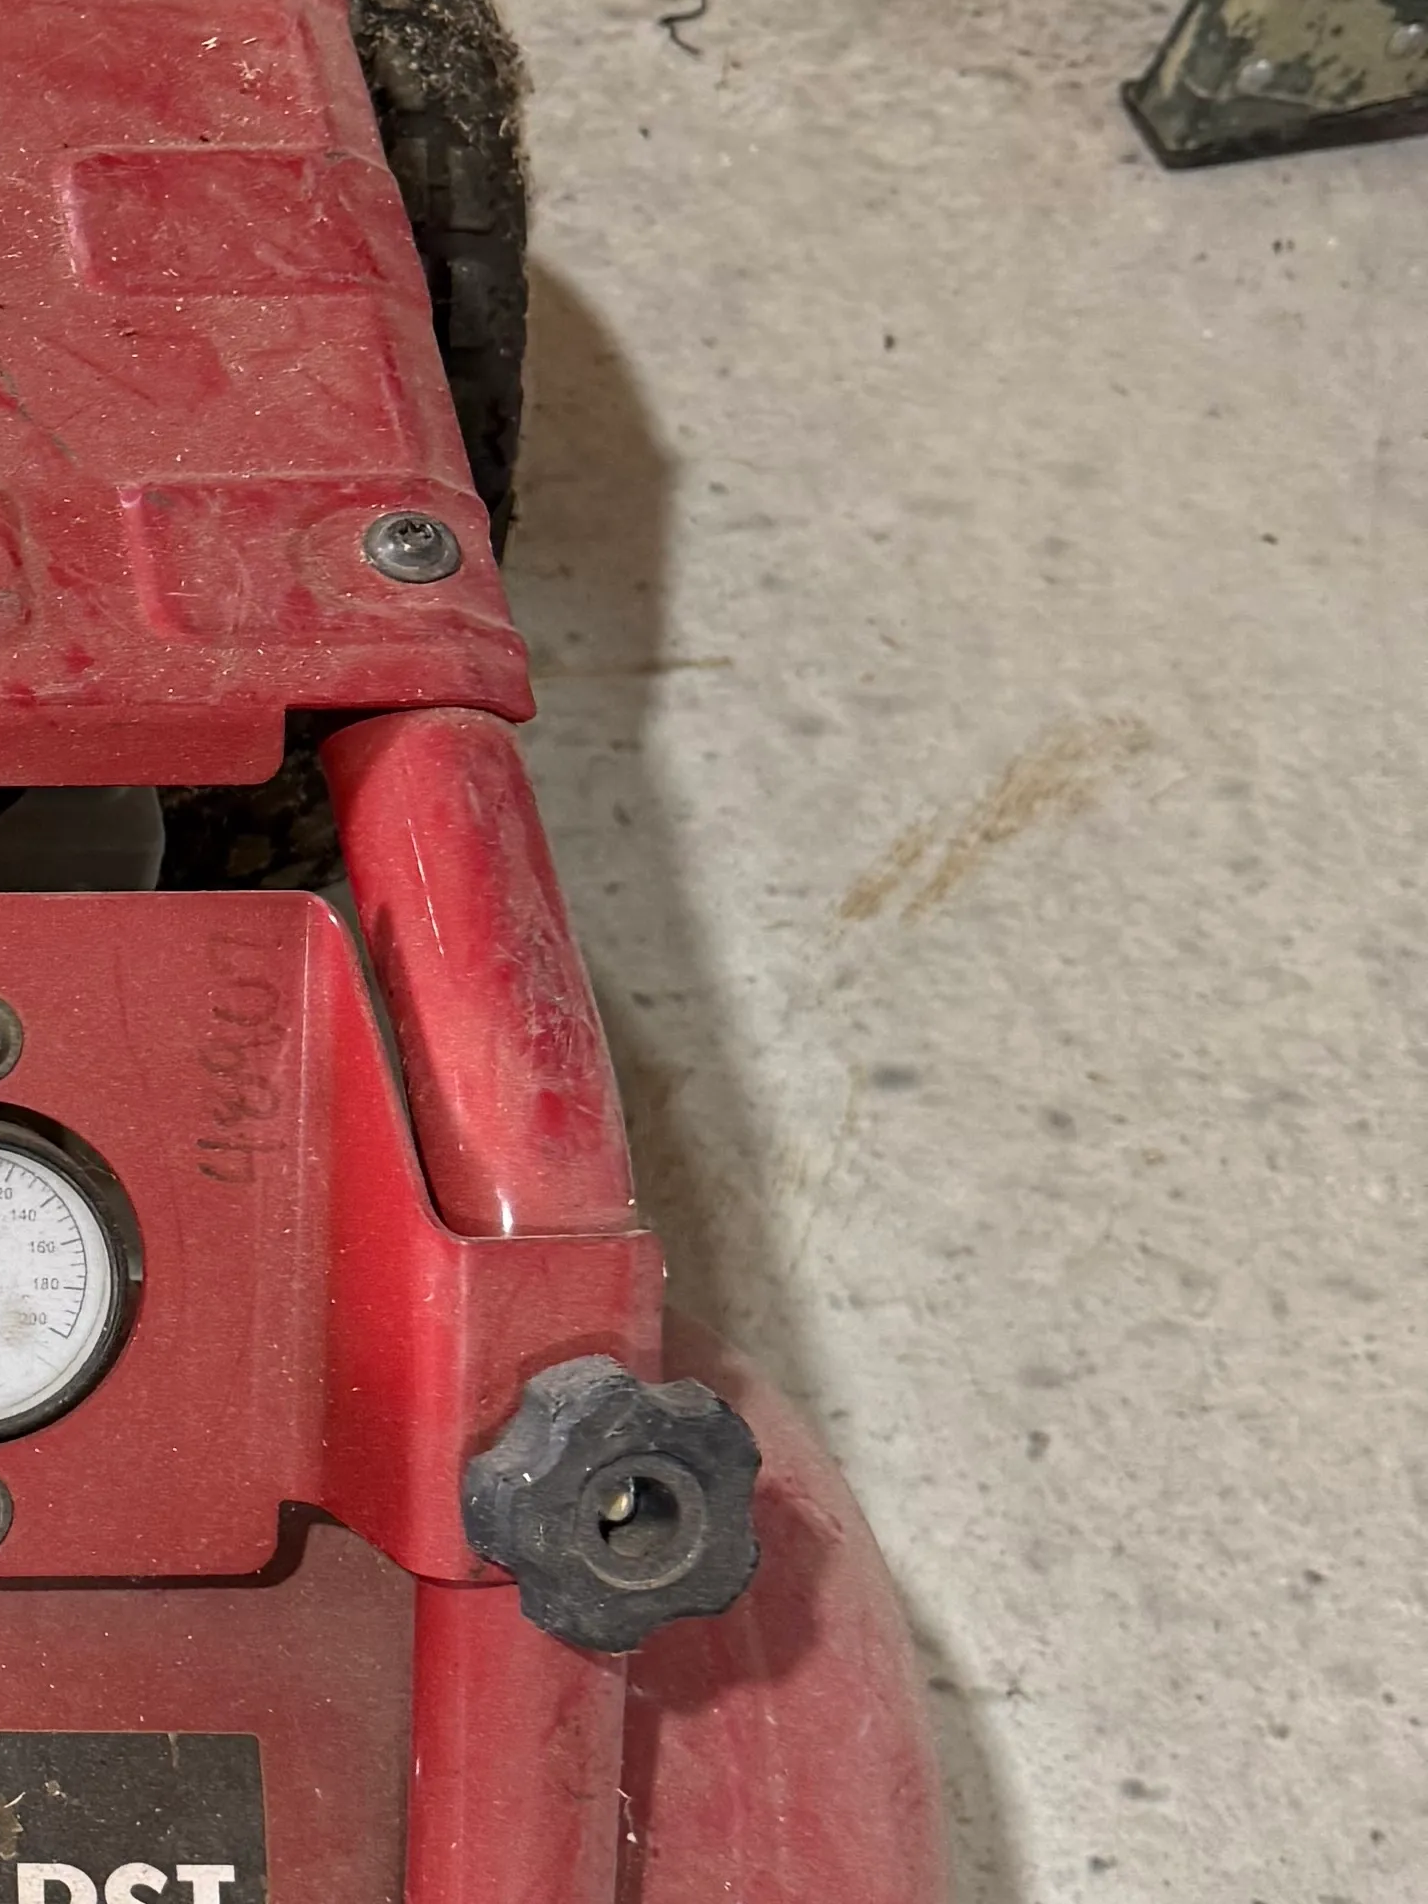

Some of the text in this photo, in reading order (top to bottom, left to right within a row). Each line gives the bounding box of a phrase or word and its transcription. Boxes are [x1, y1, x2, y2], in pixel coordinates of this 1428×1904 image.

[11, 1209, 37, 1221] 140
[29, 1241, 55, 1254] 160
[33, 1277, 59, 1290] 180
